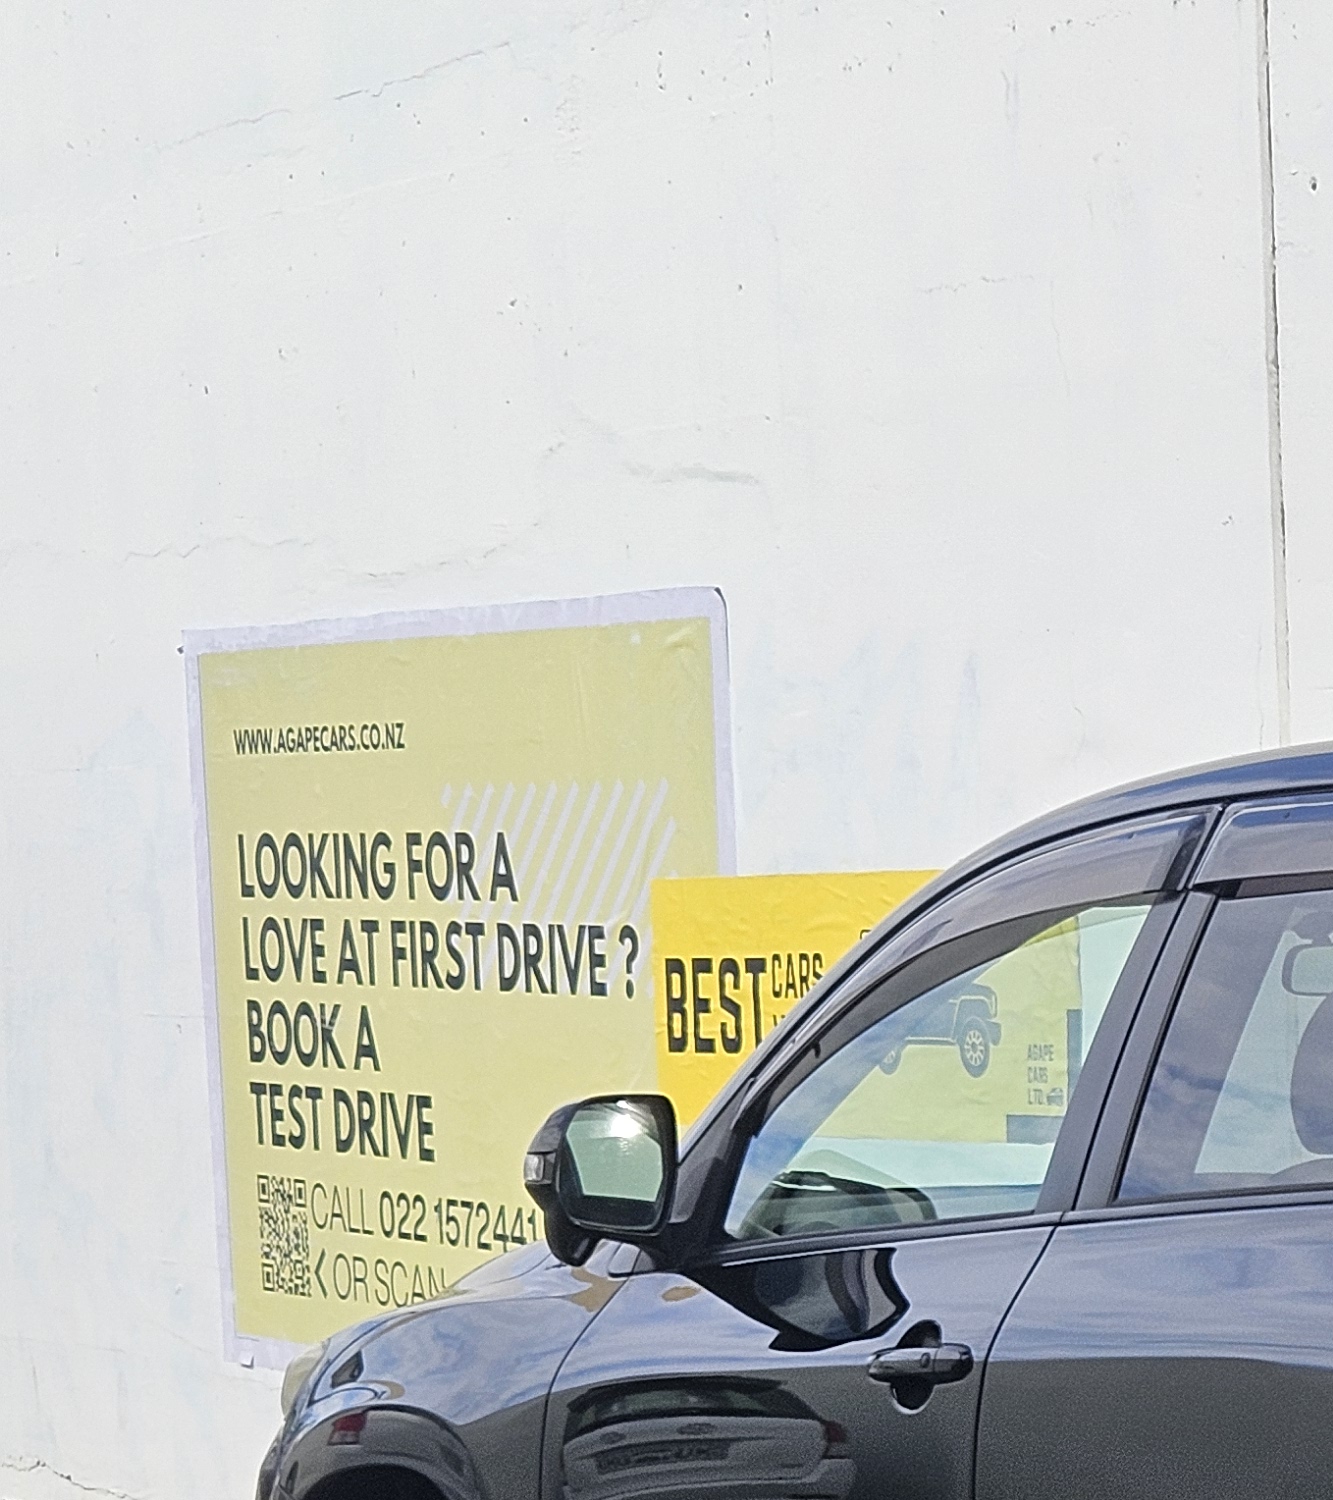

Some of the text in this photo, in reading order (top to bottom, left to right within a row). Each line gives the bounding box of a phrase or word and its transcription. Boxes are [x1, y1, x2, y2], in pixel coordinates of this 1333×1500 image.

[233, 723, 405, 754] WWW.AGAPECARS.CO.NZ
[237, 831, 519, 903] LOOKING FOR A
[241, 917, 327, 982] LOVE
[337, 919, 379, 985] AT
[391, 920, 485, 991] FIRST
[496, 924, 608, 997] DRIVE
[246, 999, 382, 1073] BOOK A
[665, 958, 767, 1054] BEST
[249, 1081, 435, 1162] TEST DRIVE
[311, 1182, 374, 1235] CALL
[379, 1190, 428, 1243] 022
[333, 1253, 369, 1303] OR
